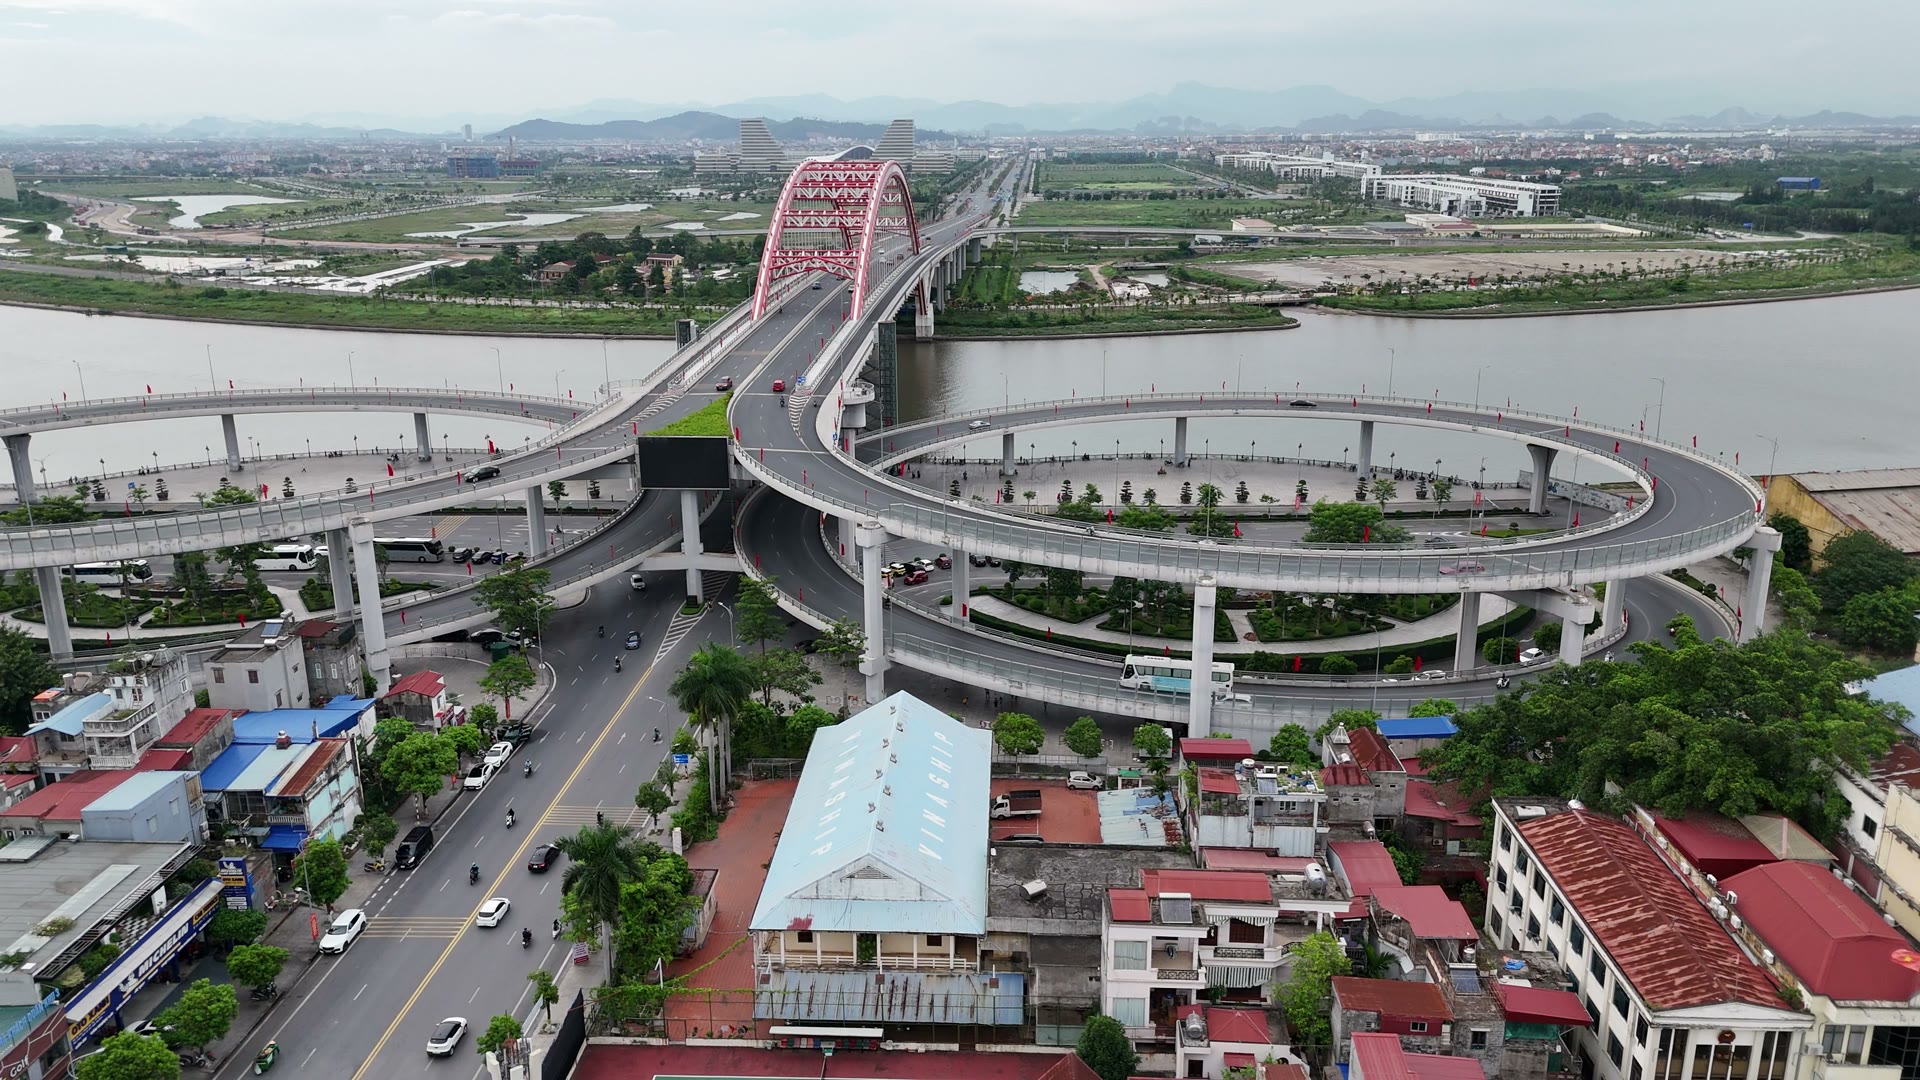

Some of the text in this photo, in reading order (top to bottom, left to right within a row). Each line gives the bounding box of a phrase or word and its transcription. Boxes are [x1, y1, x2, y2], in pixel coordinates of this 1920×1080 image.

[810, 730, 862, 856] VINASHIP
[918, 731, 954, 861] VINASHIP
[138, 922, 189, 976] MICHELIN
[9, 1054, 29, 1078] Golf
